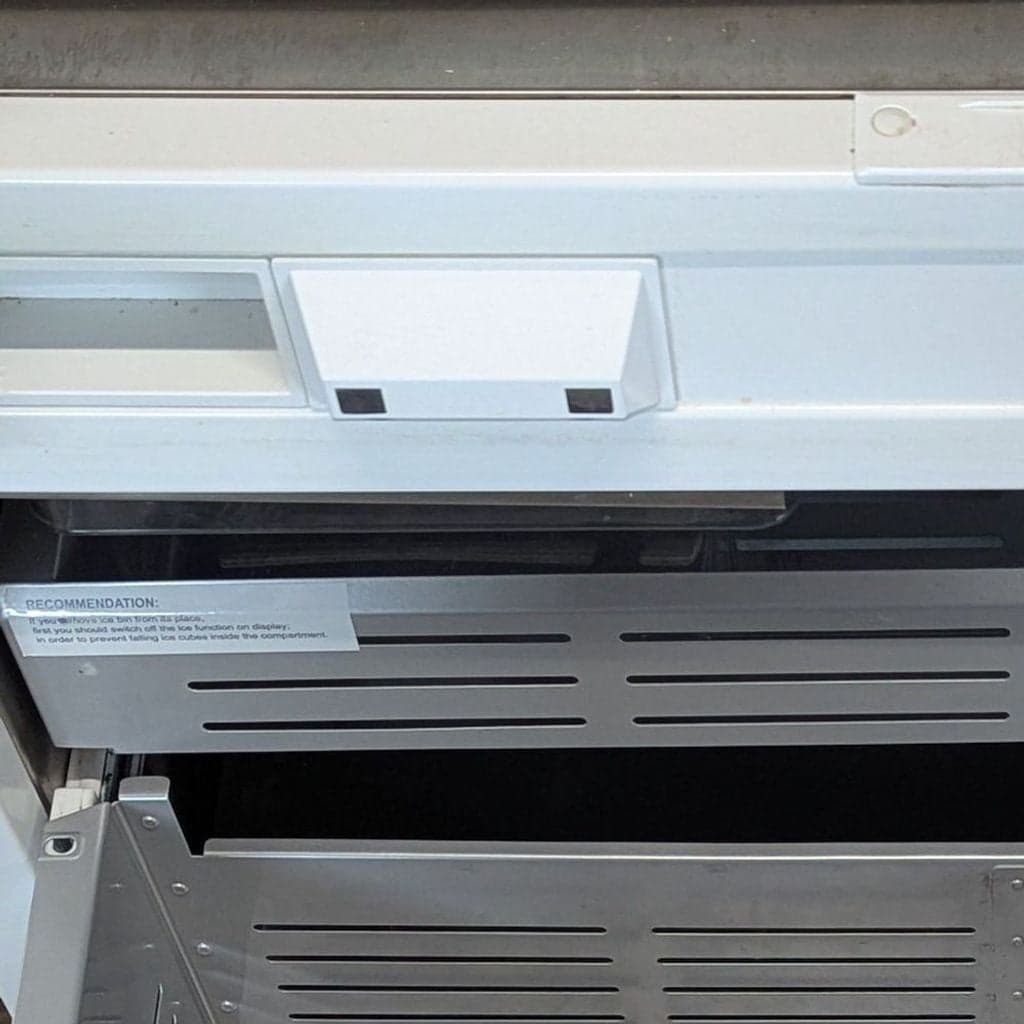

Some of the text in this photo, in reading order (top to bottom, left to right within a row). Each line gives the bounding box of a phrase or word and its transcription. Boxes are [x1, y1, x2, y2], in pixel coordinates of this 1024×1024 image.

[26, 597, 159, 610] RECOMMENDATION:
[53, 627, 73, 635] you
[111, 625, 142, 633] switch
[48, 635, 74, 643] order
[89, 635, 128, 643] prevent
[178, 633, 208, 641] cubes
[210, 632, 240, 640] inside
[260, 631, 329, 640] compartment.
